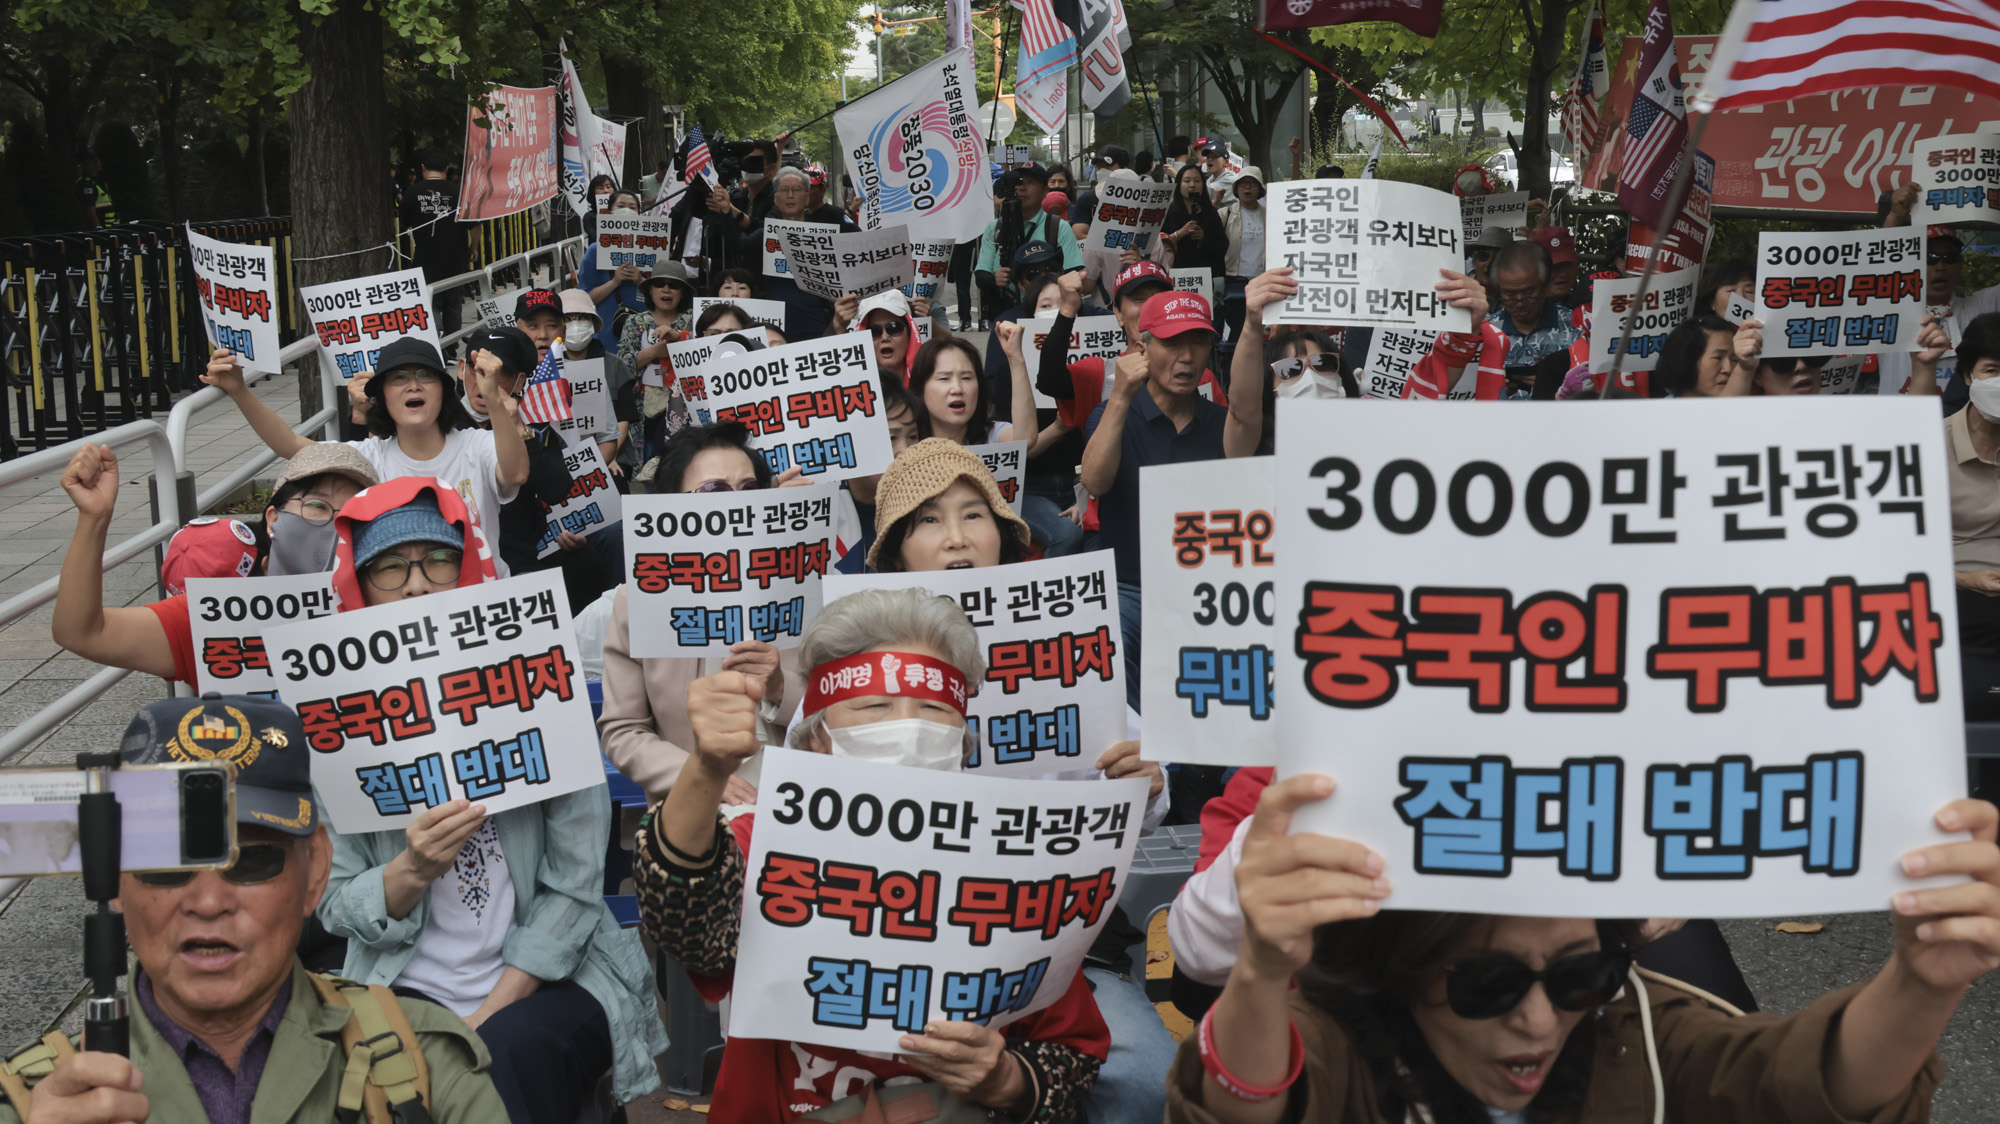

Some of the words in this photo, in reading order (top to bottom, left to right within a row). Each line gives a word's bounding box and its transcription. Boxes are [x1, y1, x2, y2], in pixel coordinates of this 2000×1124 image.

[1755, 123, 1847, 203] 관광
[1927, 147, 1976, 168] 중국인
[1106, 185, 1150, 203] 3000만
[1149, 188, 1174, 204] 관광객
[1284, 186, 1359, 213] 중국인
[1487, 202, 1525, 214] 유치보다
[1926, 186, 1986, 211] 무비자
[600, 220, 640, 232] 3000만
[641, 221, 669, 233] 관광객
[1098, 203, 1141, 226] 중국인
[600, 234, 634, 249] 중국인
[636, 235, 668, 250] 무비자
[787, 232, 834, 250] 중국인
[1104, 228, 1133, 251] 절대
[1283, 218, 1359, 246] 관광객
[1366, 219, 1457, 254] 유치보다
[1627, 243, 1672, 263] SECURTY
[1767, 242, 1862, 266] 3000만
[1866, 237, 1921, 263] 관광객
[216, 252, 267, 281] 관광객
[610, 252, 633, 266] 절대
[635, 253, 656, 268] 반대
[791, 249, 838, 268] 관광객
[841, 243, 908, 268] 유치보다
[1283, 251, 1358, 279] 자국민
[798, 264, 841, 286] 자국민
[802, 279, 844, 299] 안전이
[1178, 276, 1203, 287] 관광객
[1762, 274, 1845, 309] 중국인
[1848, 269, 1923, 306] 무비자
[214, 282, 270, 322] 무비자
[308, 288, 361, 313] 3000만
[366, 277, 420, 306] 관광객
[480, 301, 499, 317] 중국인
[1164, 300, 1178, 313] STOP
[1179, 298, 1190, 307] THE
[1365, 288, 1447, 318] 먼저다!
[218, 324, 255, 361] 반대
[315, 316, 360, 347] 중국인
[361, 304, 428, 335] 무비자
[1084, 330, 1128, 349] 관광객
[1381, 330, 1433, 355] 관광객
[1785, 314, 1840, 348] 절대
[1844, 313, 1899, 346] 반대
[335, 351, 366, 379] 절대
[711, 358, 789, 396] 3000만
[795, 344, 868, 381] 관광객
[1375, 353, 1415, 377] 자국
[787, 380, 877, 429] 무비자
[758, 443, 790, 475] 대
[793, 432, 857, 476] 반대
[1305, 448, 1688, 547] 3000만
[1711, 443, 1927, 542] 관광객
[561, 502, 604, 535] 반대
[633, 505, 755, 538] 3000만
[762, 496, 832, 533] 관광객
[634, 548, 741, 593] 중국인
[747, 538, 832, 586] 무비자
[200, 587, 333, 622] 3000만
[1006, 569, 1109, 624] 관광객
[281, 615, 439, 681] 3000만
[449, 589, 558, 652] 관광객
[671, 605, 743, 647] 절대
[749, 596, 804, 645] 반대
[987, 625, 1115, 692] 무비자
[1294, 580, 1628, 713] 중국인
[1646, 572, 1943, 713] 무비자
[820, 663, 872, 695] 이재명
[904, 663, 944, 692] 투쟁
[1175, 644, 1275, 721] 무비
[296, 677, 435, 754] 중국인
[439, 644, 575, 723] 무비자
[988, 703, 1081, 765] 반대
[356, 755, 450, 817] 절대
[454, 727, 550, 801] 반대
[772, 781, 978, 853] 3000만
[991, 801, 1131, 857] 관광객
[1395, 754, 1624, 882] 절대
[1644, 749, 1865, 880] 반대
[756, 851, 940, 942] 중국인
[949, 866, 1116, 946] 무비자
[804, 955, 933, 1034] 절대
[941, 956, 1051, 1027] 반대
